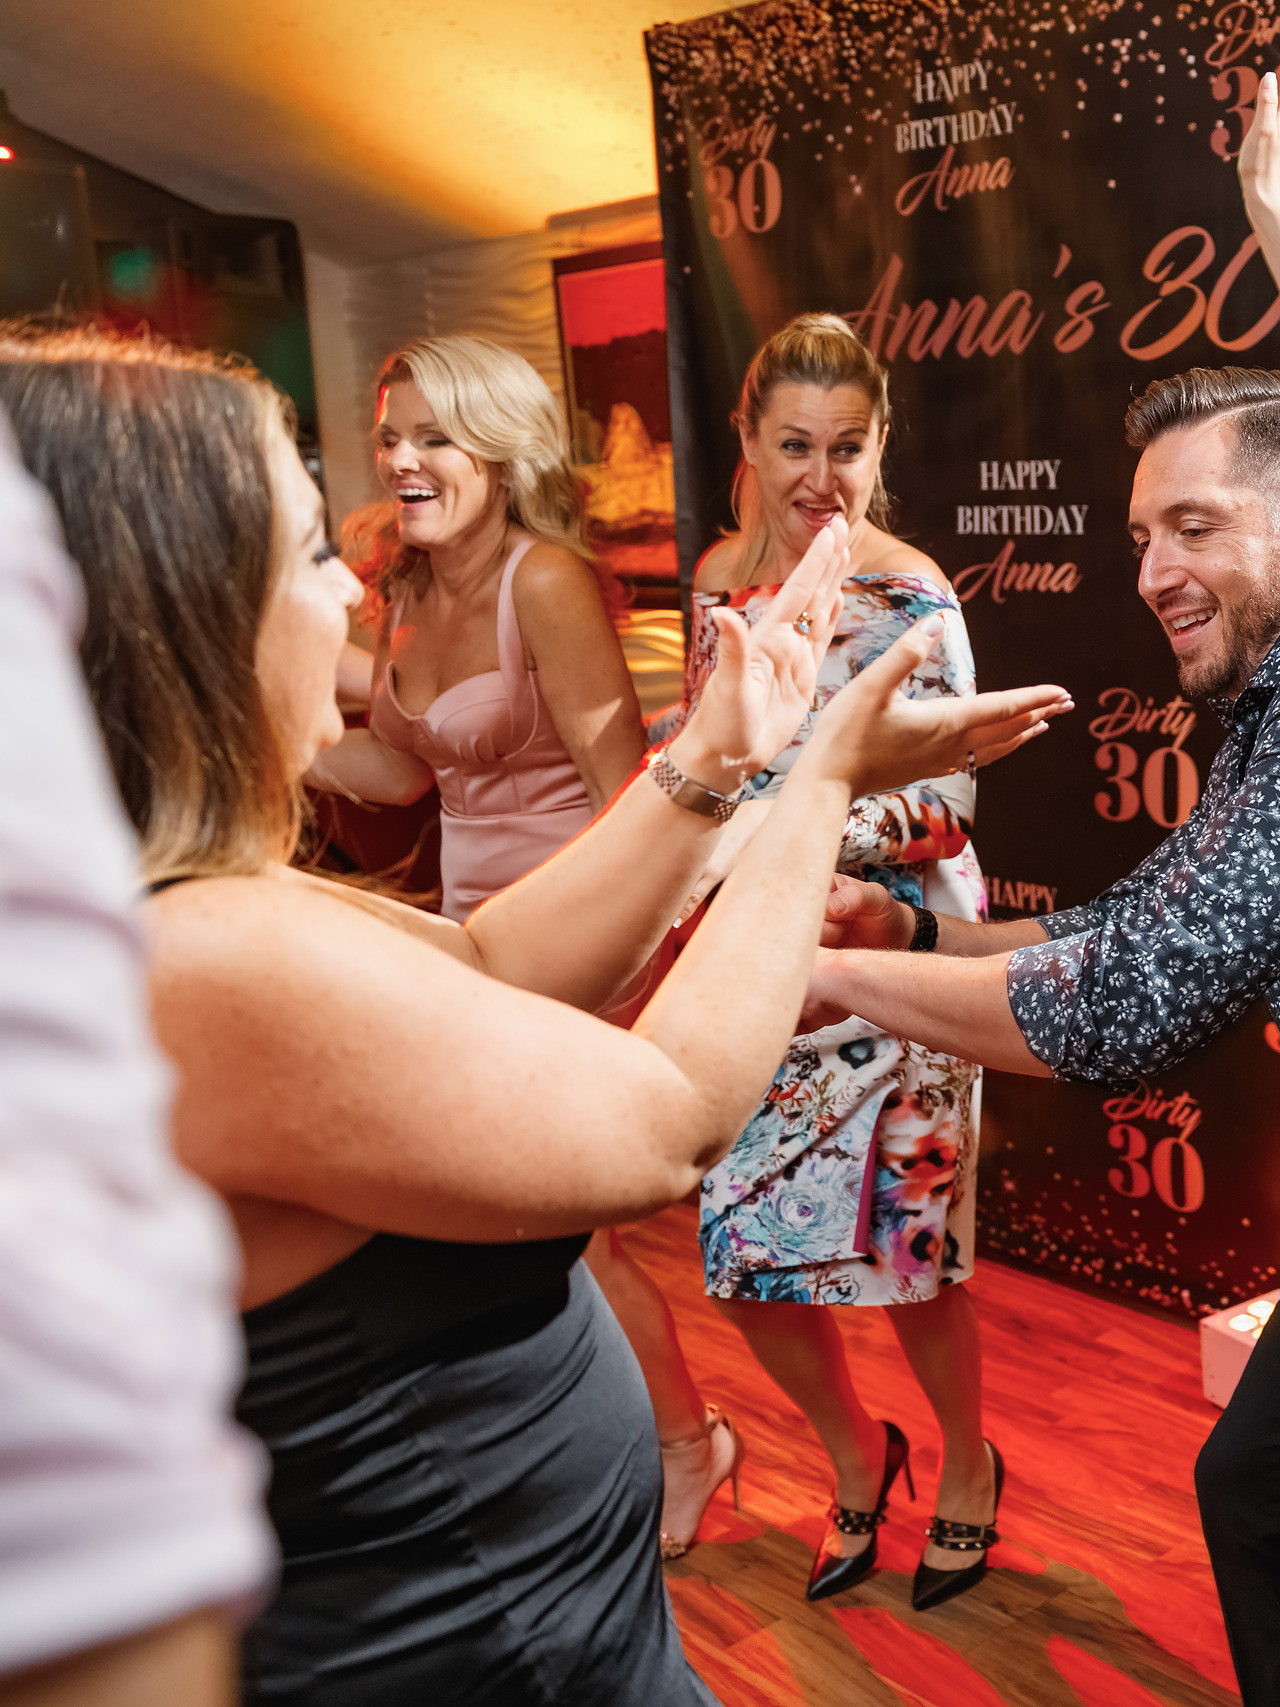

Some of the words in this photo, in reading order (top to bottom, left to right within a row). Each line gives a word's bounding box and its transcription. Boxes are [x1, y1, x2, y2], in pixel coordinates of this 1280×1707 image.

[914, 60, 988, 103] HAPPY
[896, 102, 1017, 153] BIRTHDAY
[895, 145, 1017, 217] Anna
[843, 243, 1111, 362] Anna's
[980, 459, 1061, 491] HAPPY
[956, 504, 1088, 536] BIRTHDAY
[953, 539, 1082, 604] Anna
[1089, 687, 1198, 752] Dirty
[1094, 743, 1200, 829] 30
[984, 875, 1058, 914] HAPPY
[1102, 1077, 1202, 1142] Dirty
[1107, 1123, 1205, 1213] 30
